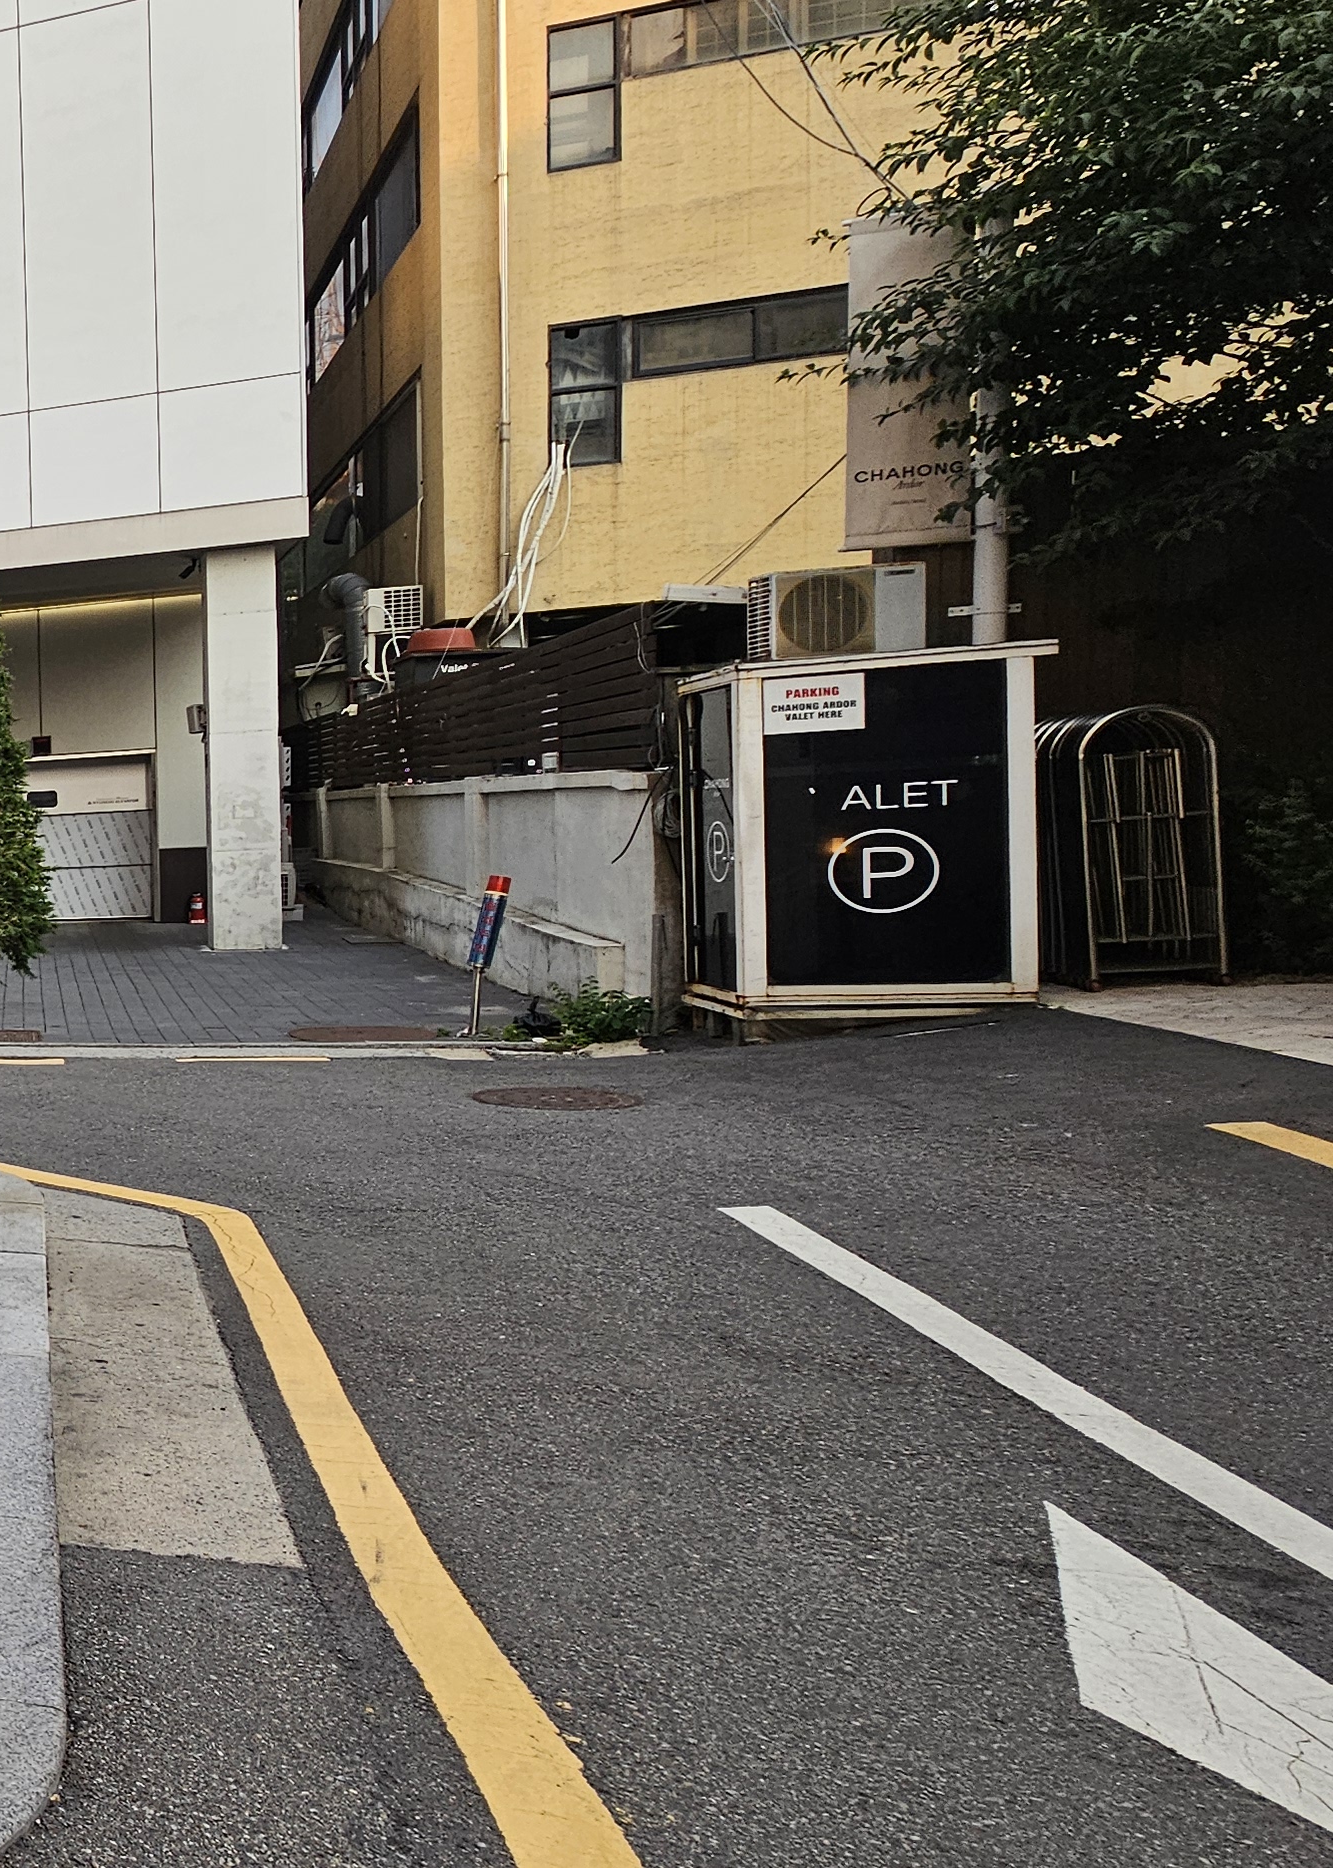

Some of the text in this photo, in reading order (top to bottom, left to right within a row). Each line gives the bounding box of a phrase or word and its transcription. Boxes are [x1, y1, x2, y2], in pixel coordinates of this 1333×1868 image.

[854, 460, 964, 483] CHAHONG
[785, 686, 840, 699] PARKING
[771, 702, 819, 713] CHAHONG
[785, 710, 843, 721] VALET HERE
[808, 779, 959, 811] ALET
